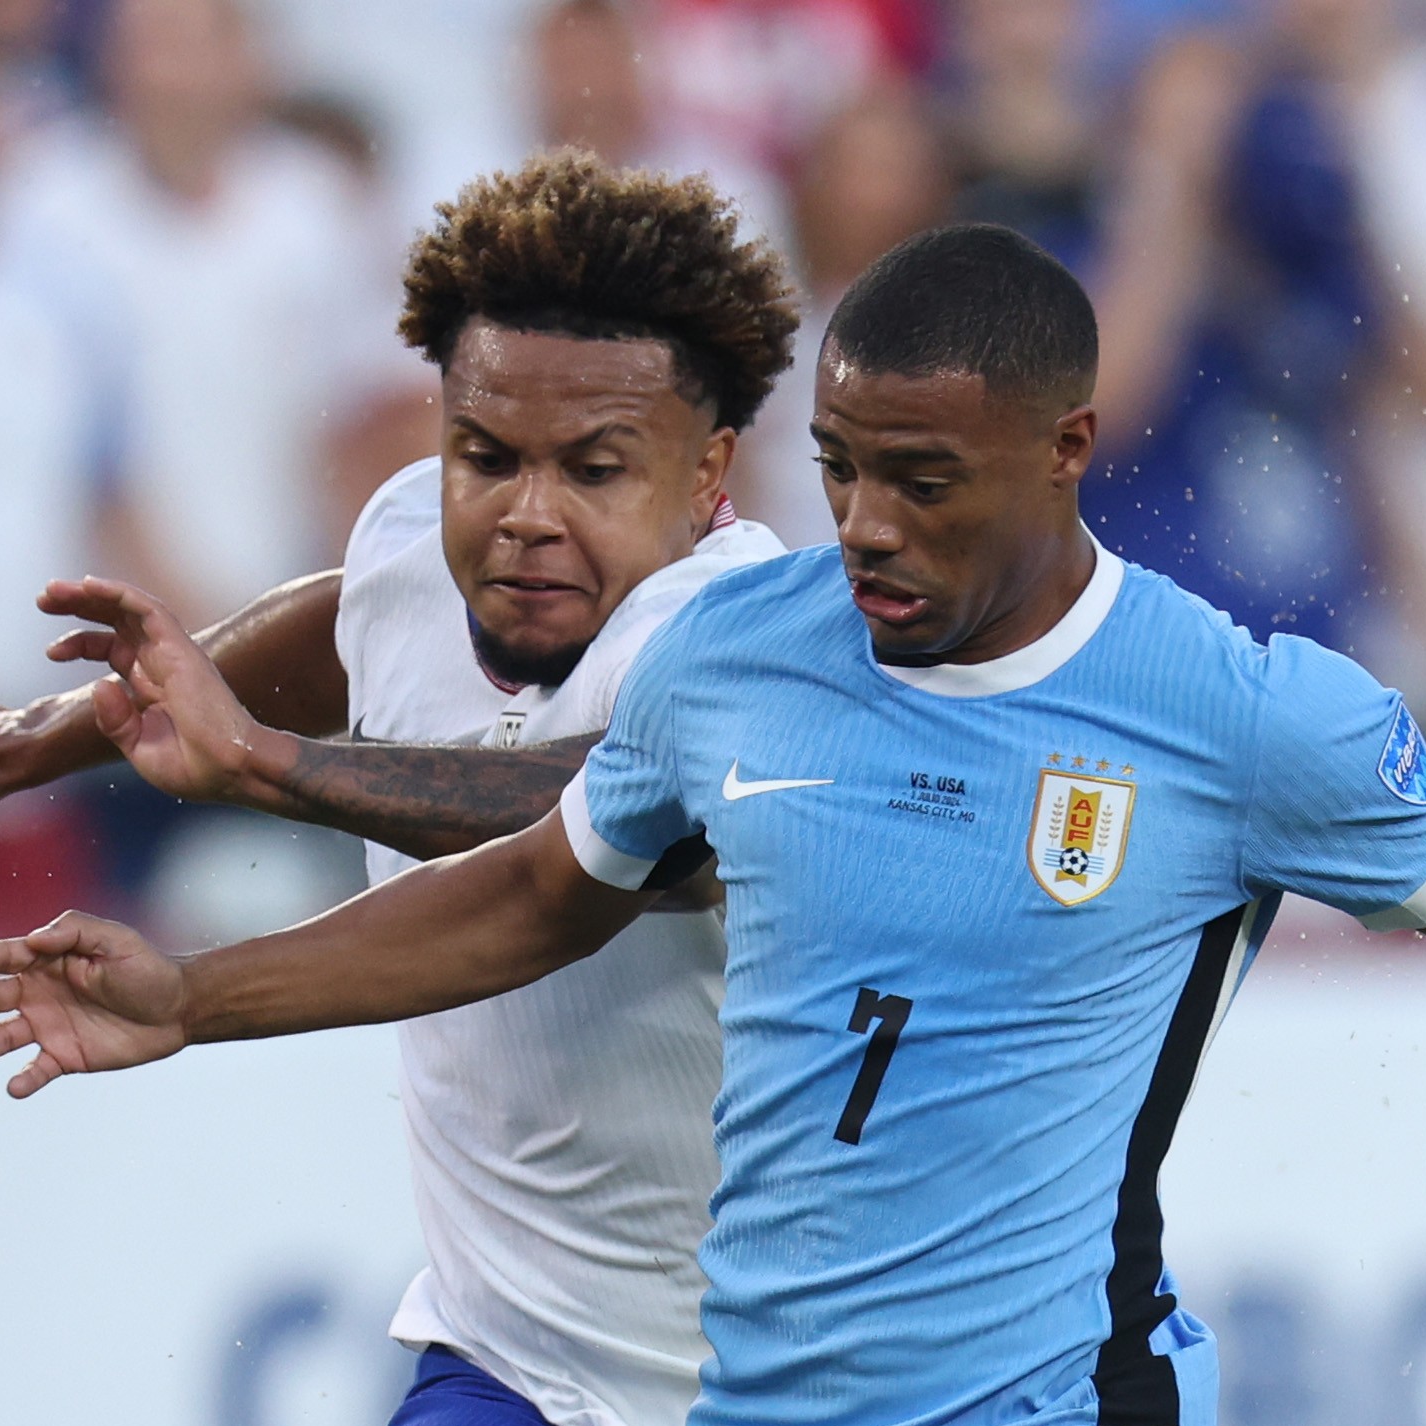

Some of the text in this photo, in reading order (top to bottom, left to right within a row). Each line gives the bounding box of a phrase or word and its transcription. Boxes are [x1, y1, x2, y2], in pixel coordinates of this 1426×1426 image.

[911, 772, 965, 795] VS. USA
[887, 798, 931, 814] KANSAS
[958, 810, 975, 823] MO
[1067, 798, 1093, 842] AUF
[833, 986, 914, 1146] 7
